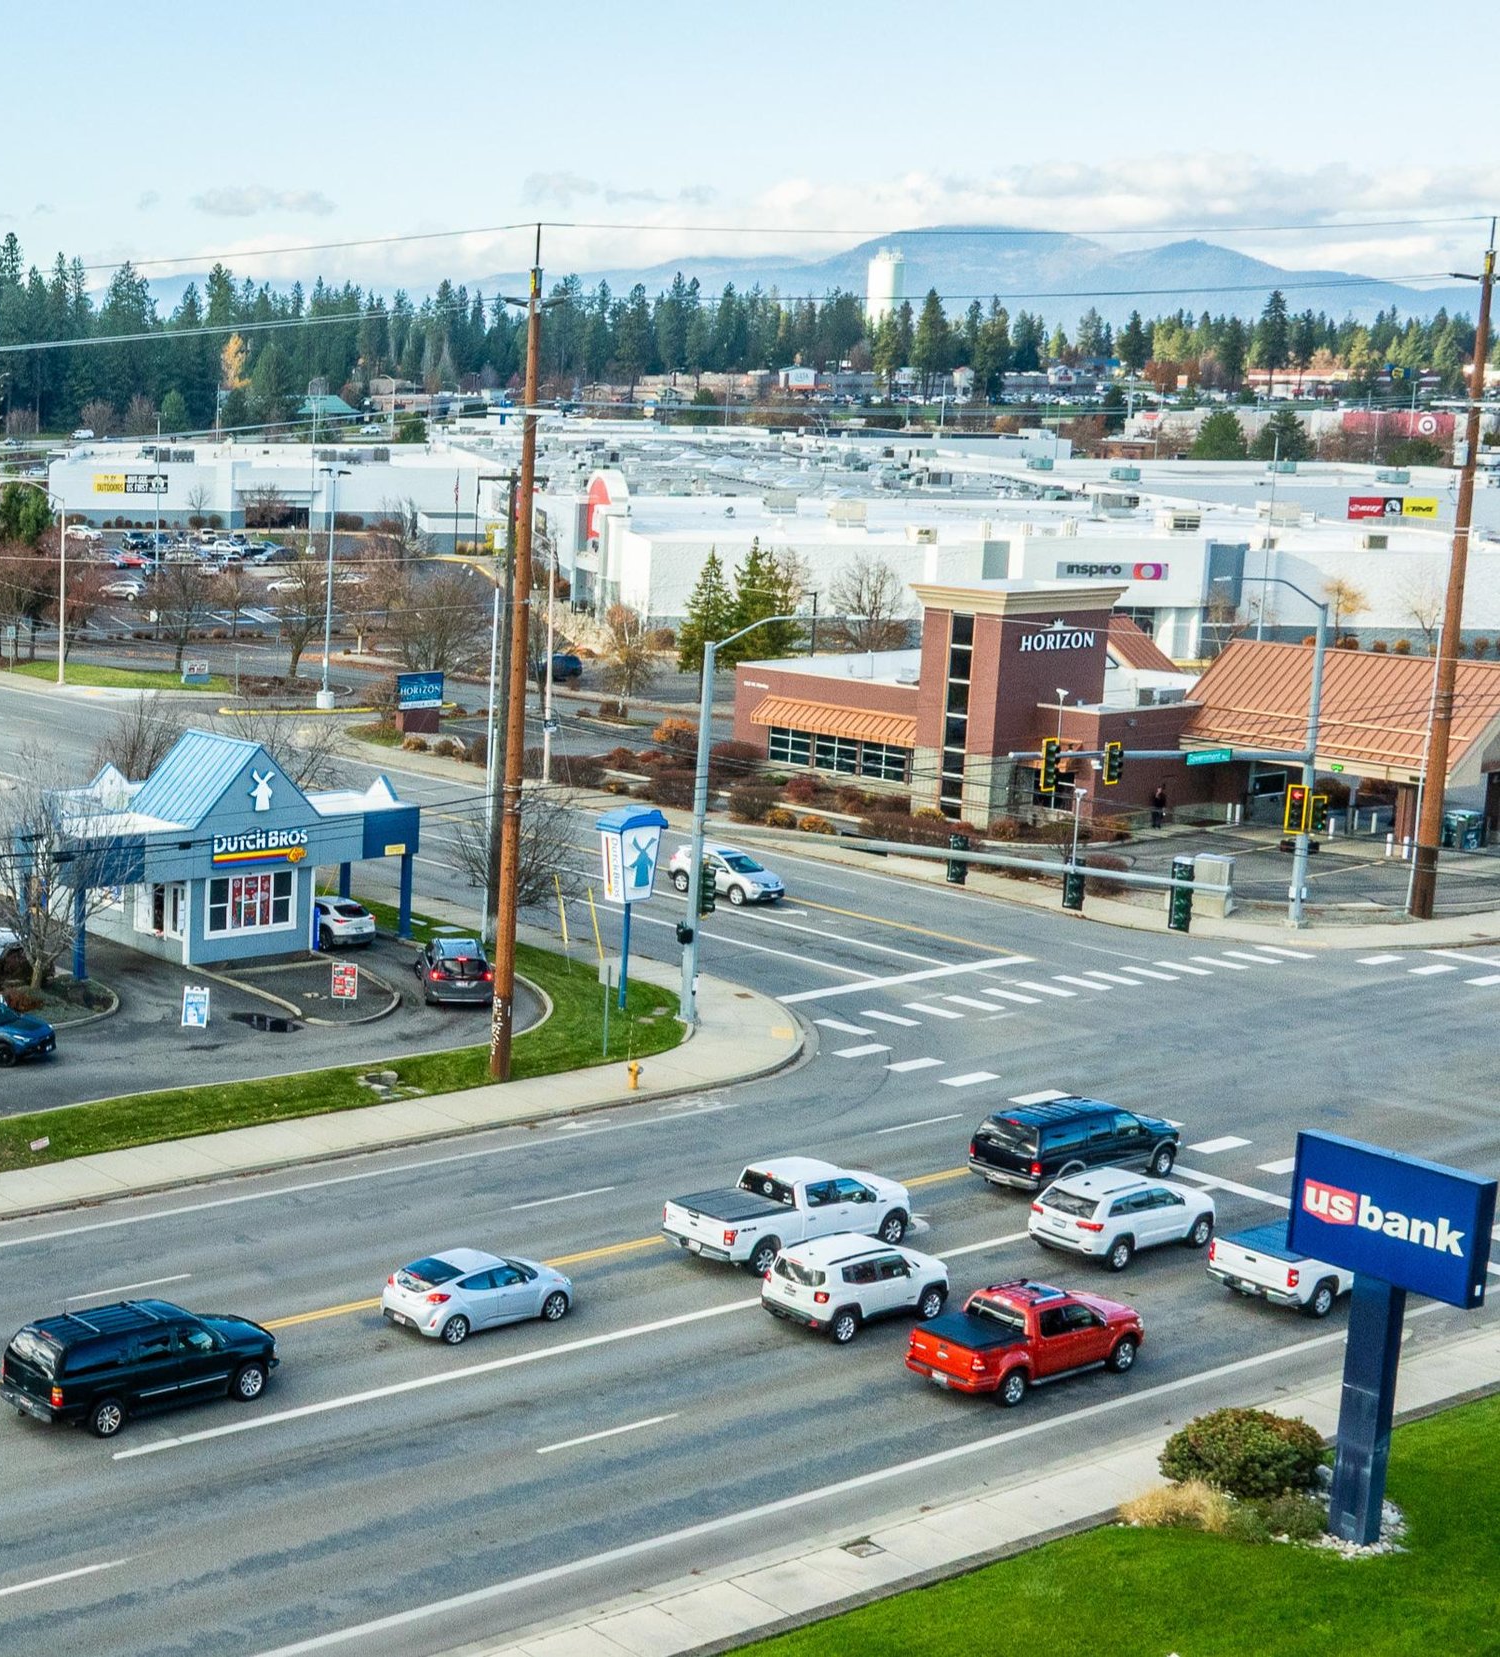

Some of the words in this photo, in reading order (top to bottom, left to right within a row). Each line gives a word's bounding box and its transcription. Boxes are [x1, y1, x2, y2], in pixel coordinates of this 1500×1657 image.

[1066, 564, 1122, 577] inspiro
[1019, 631, 1095, 652] HORIZON
[400, 684, 441, 696] HORIZON
[213, 831, 266, 853] DUTCH
[268, 829, 308, 847] BROS
